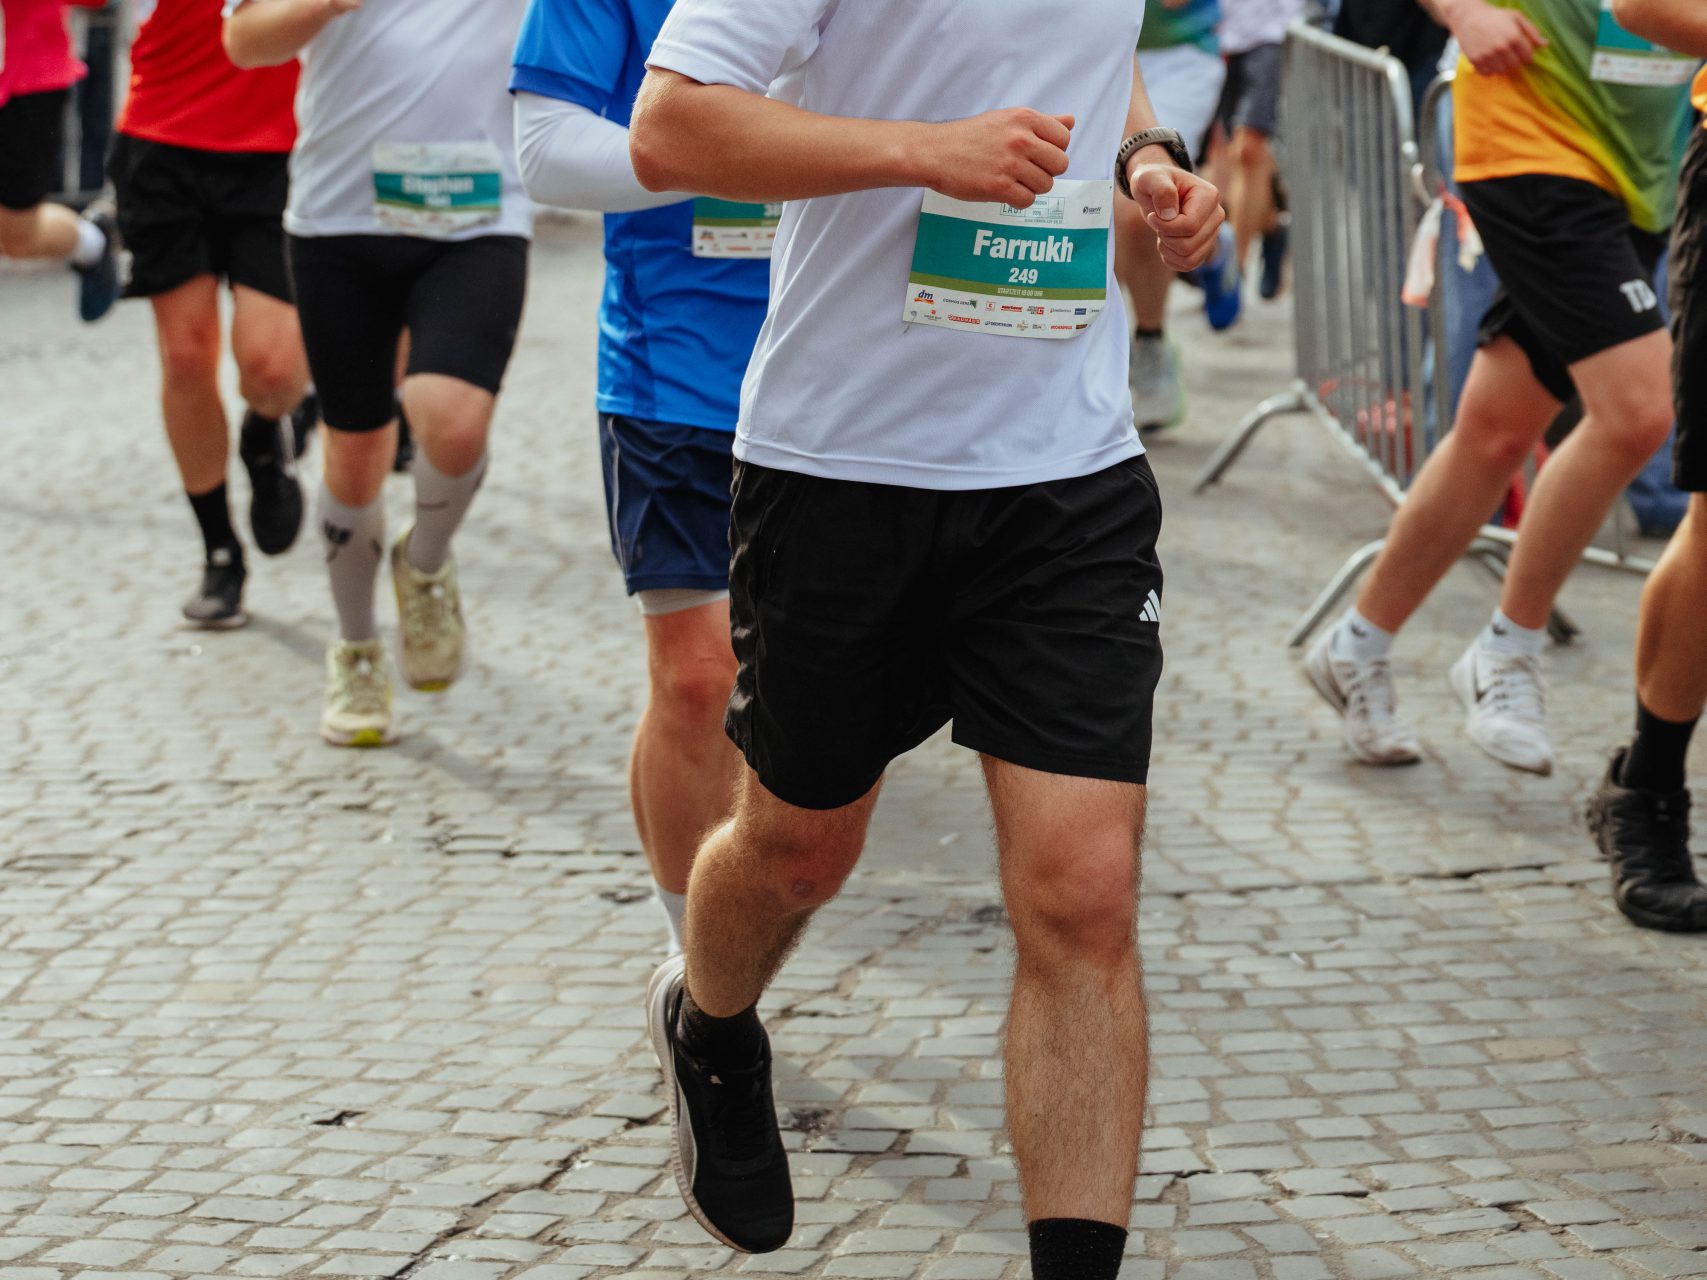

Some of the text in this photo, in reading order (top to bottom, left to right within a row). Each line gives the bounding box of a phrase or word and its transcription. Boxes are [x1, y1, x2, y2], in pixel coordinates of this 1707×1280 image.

[973, 229, 1074, 263] Farrukh
[1008, 267, 1038, 284] 249
[918, 290, 933, 299] dm
